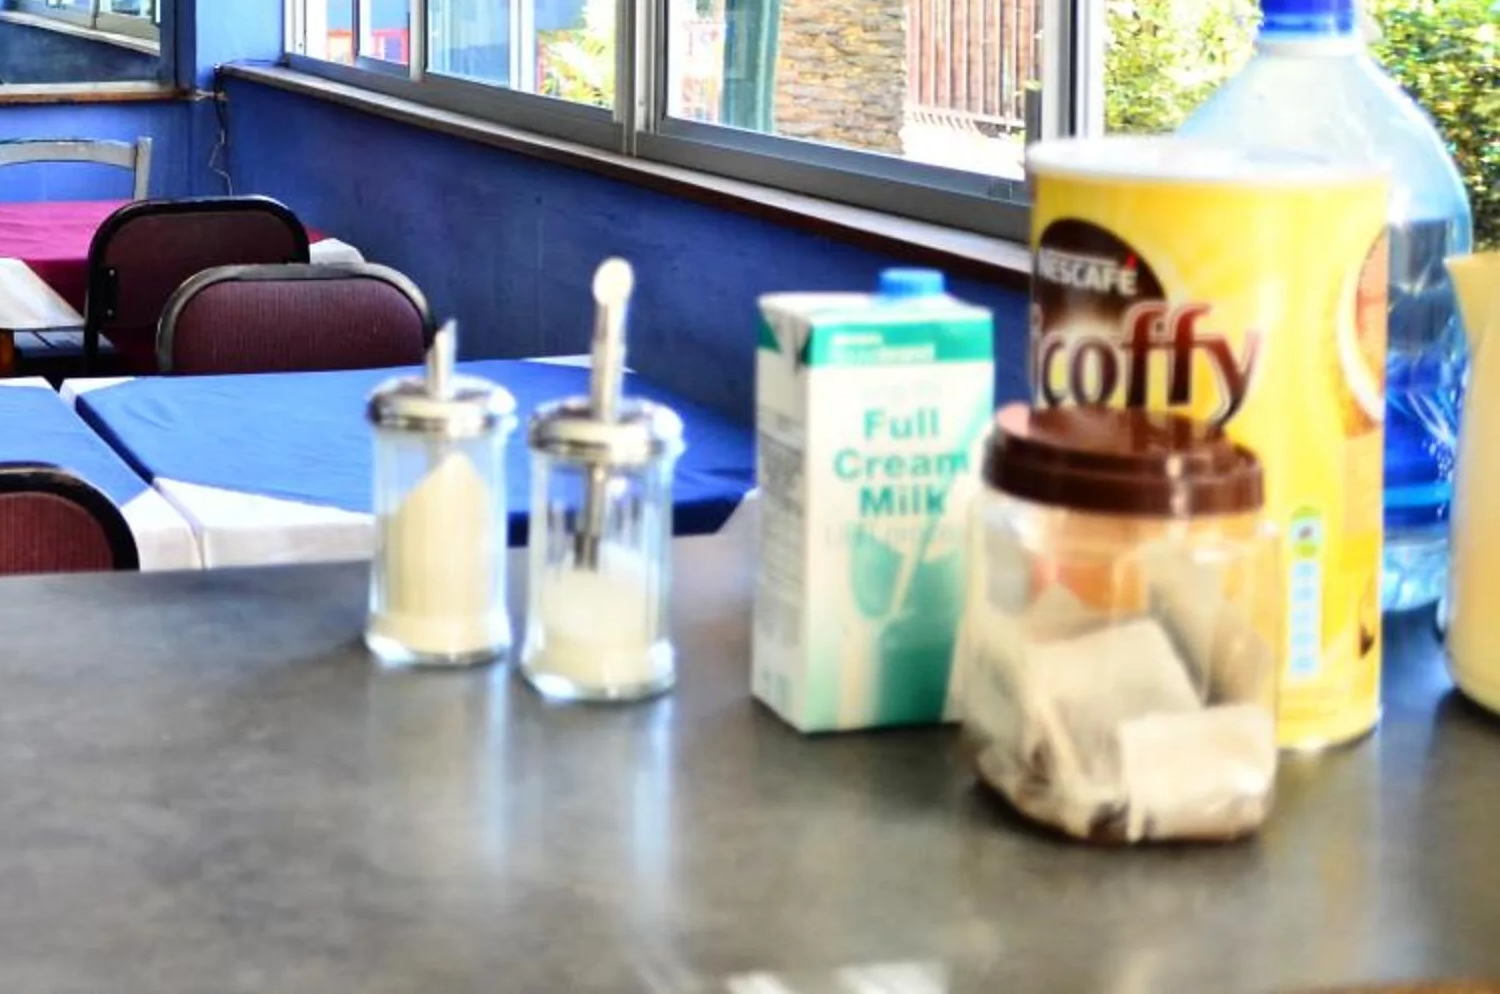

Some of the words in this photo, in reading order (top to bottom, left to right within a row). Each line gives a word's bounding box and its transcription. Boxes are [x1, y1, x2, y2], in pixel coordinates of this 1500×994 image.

[863, 407, 940, 441] Full
[834, 449, 968, 482] Cream
[860, 485, 945, 517] Milk
